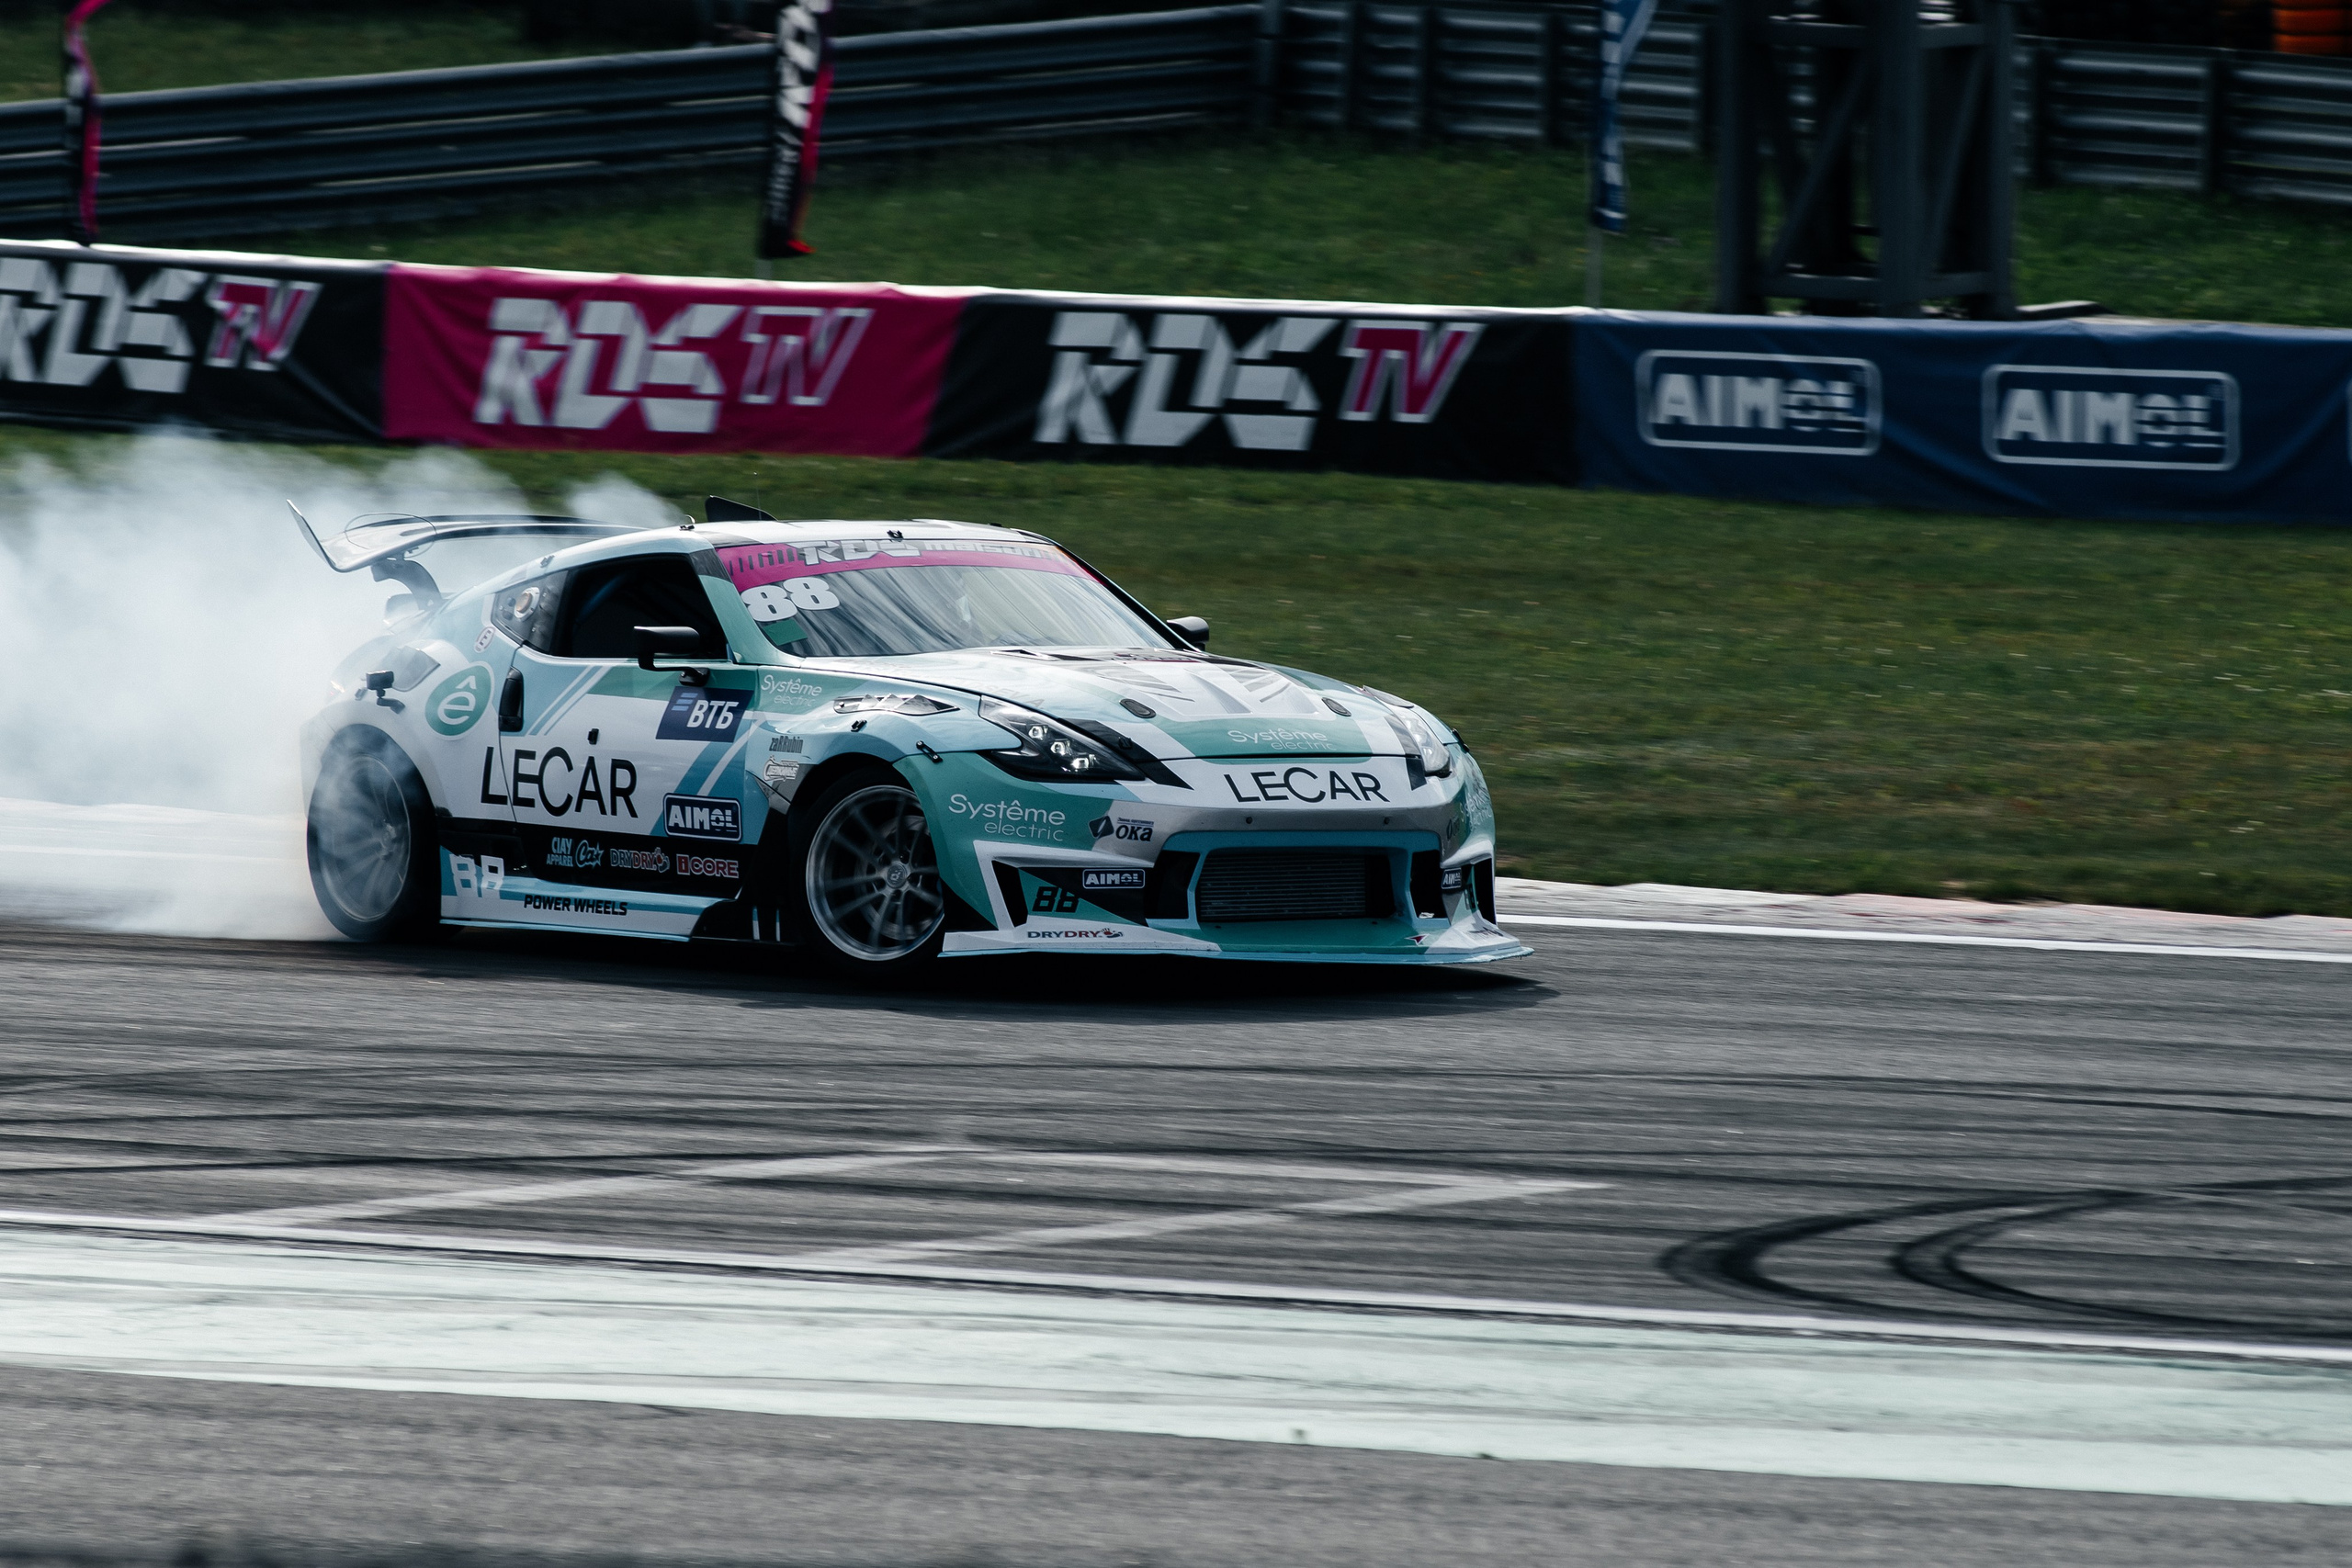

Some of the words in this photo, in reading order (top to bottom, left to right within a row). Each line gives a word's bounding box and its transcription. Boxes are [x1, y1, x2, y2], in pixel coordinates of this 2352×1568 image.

[0, 257, 210, 393] RDS
[206, 275, 322, 371] TV
[473, 297, 744, 433] RDS
[741, 306, 875, 407] TV
[1034, 310, 1345, 451] RDS
[1338, 318, 1488, 423] TV
[786, 540, 921, 566] RDS
[741, 577, 841, 622] 88
[761, 674, 822, 697] Systême
[774, 693, 817, 707] electric
[686, 699, 740, 729] ВТБ
[1227, 728, 1329, 744] Systême
[1270, 738, 1338, 751] electric
[481, 745, 639, 818] LECAR
[1223, 766, 1391, 804] LECAR
[668, 804, 738, 833] AIMOL
[948, 793, 1067, 826] Systême
[983, 818, 1065, 842] electric
[546, 853, 574, 868] APPAREL
[1085, 873, 1142, 886] AIMOL
[524, 895, 571, 912] POWER
[573, 897, 628, 917] WHEELS
